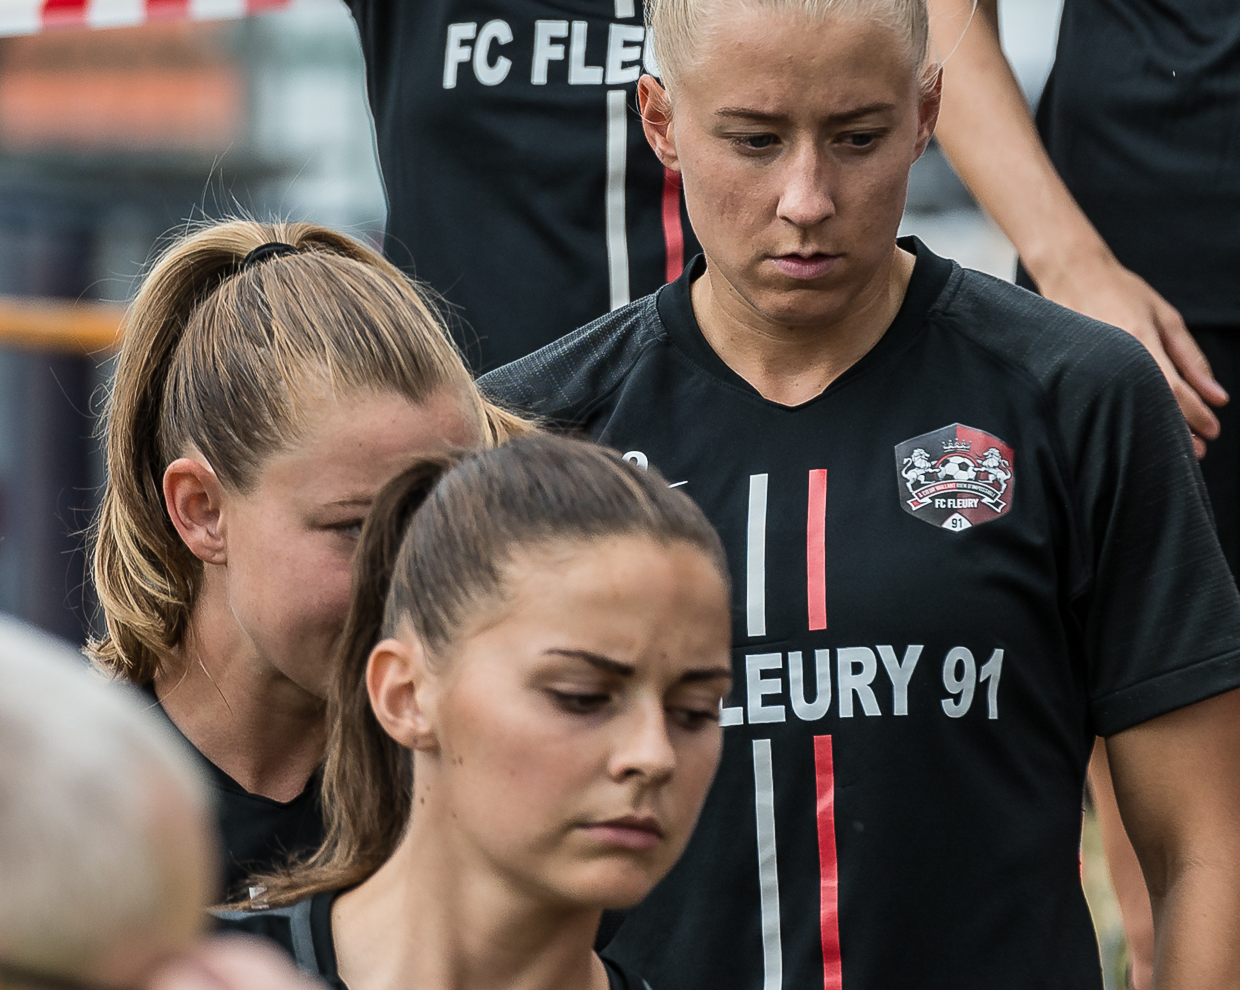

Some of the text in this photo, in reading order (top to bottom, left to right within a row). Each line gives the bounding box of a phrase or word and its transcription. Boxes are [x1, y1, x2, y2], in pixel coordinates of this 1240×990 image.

[442, 18, 661, 89] FC FLE
[934, 498, 979, 509] FC FLEURY
[951, 518, 963, 528] 91
[941, 646, 1004, 720] 91
